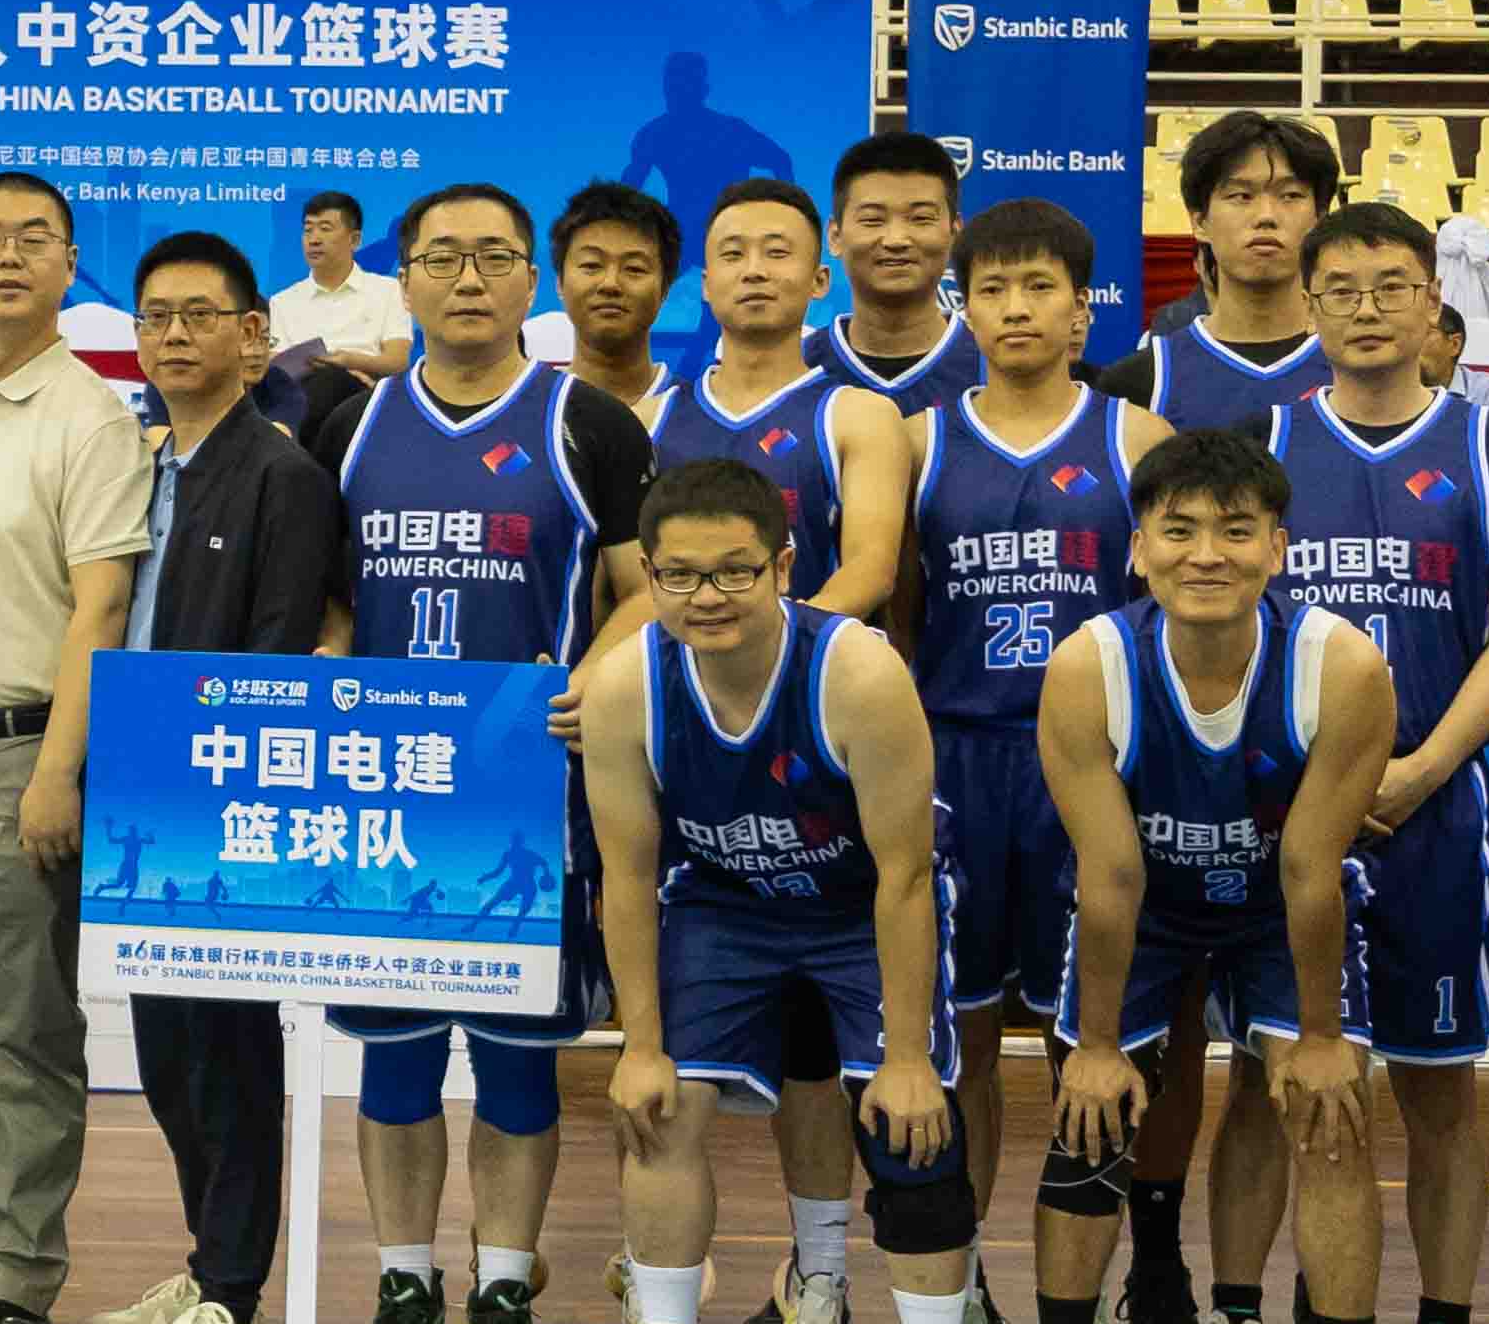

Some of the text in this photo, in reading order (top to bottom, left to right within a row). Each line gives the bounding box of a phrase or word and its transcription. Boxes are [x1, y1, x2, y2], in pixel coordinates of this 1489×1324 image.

[983, 17, 1128, 39] Stanbic Bank
[84, 86, 283, 113] BASKETBALL
[290, 88, 510, 114] TOURNAMENT
[982, 149, 1125, 172] Stanbic Bank
[78, 183, 131, 201] Bank
[137, 183, 200, 205] Kenya
[206, 184, 286, 202] Limited
[1087, 283, 1123, 304] ank
[363, 557, 526, 583] POWERCHINA
[948, 573, 1098, 600] POWERCHINA
[1290, 581, 1453, 612] POWERCHINA
[408, 587, 460, 660] 11
[984, 601, 1054, 669] 25
[231, 679, 308, 698] 华联文体
[365, 689, 467, 708] Stanbic Bank
[190, 724, 457, 795] 中国电建
[218, 802, 418, 869] 篮球队
[1205, 869, 1247, 905] 2
[116, 964, 138, 976] THE
[161, 967, 214, 981] STANBIC
[218, 969, 252, 982] BANK
[256, 972, 297, 985] KENYA
[300, 974, 341, 987] CHINA
[344, 976, 425, 992] BASKETBALL
[430, 979, 520, 997] TOURNAMENT
[1433, 976, 1457, 1034] 1
